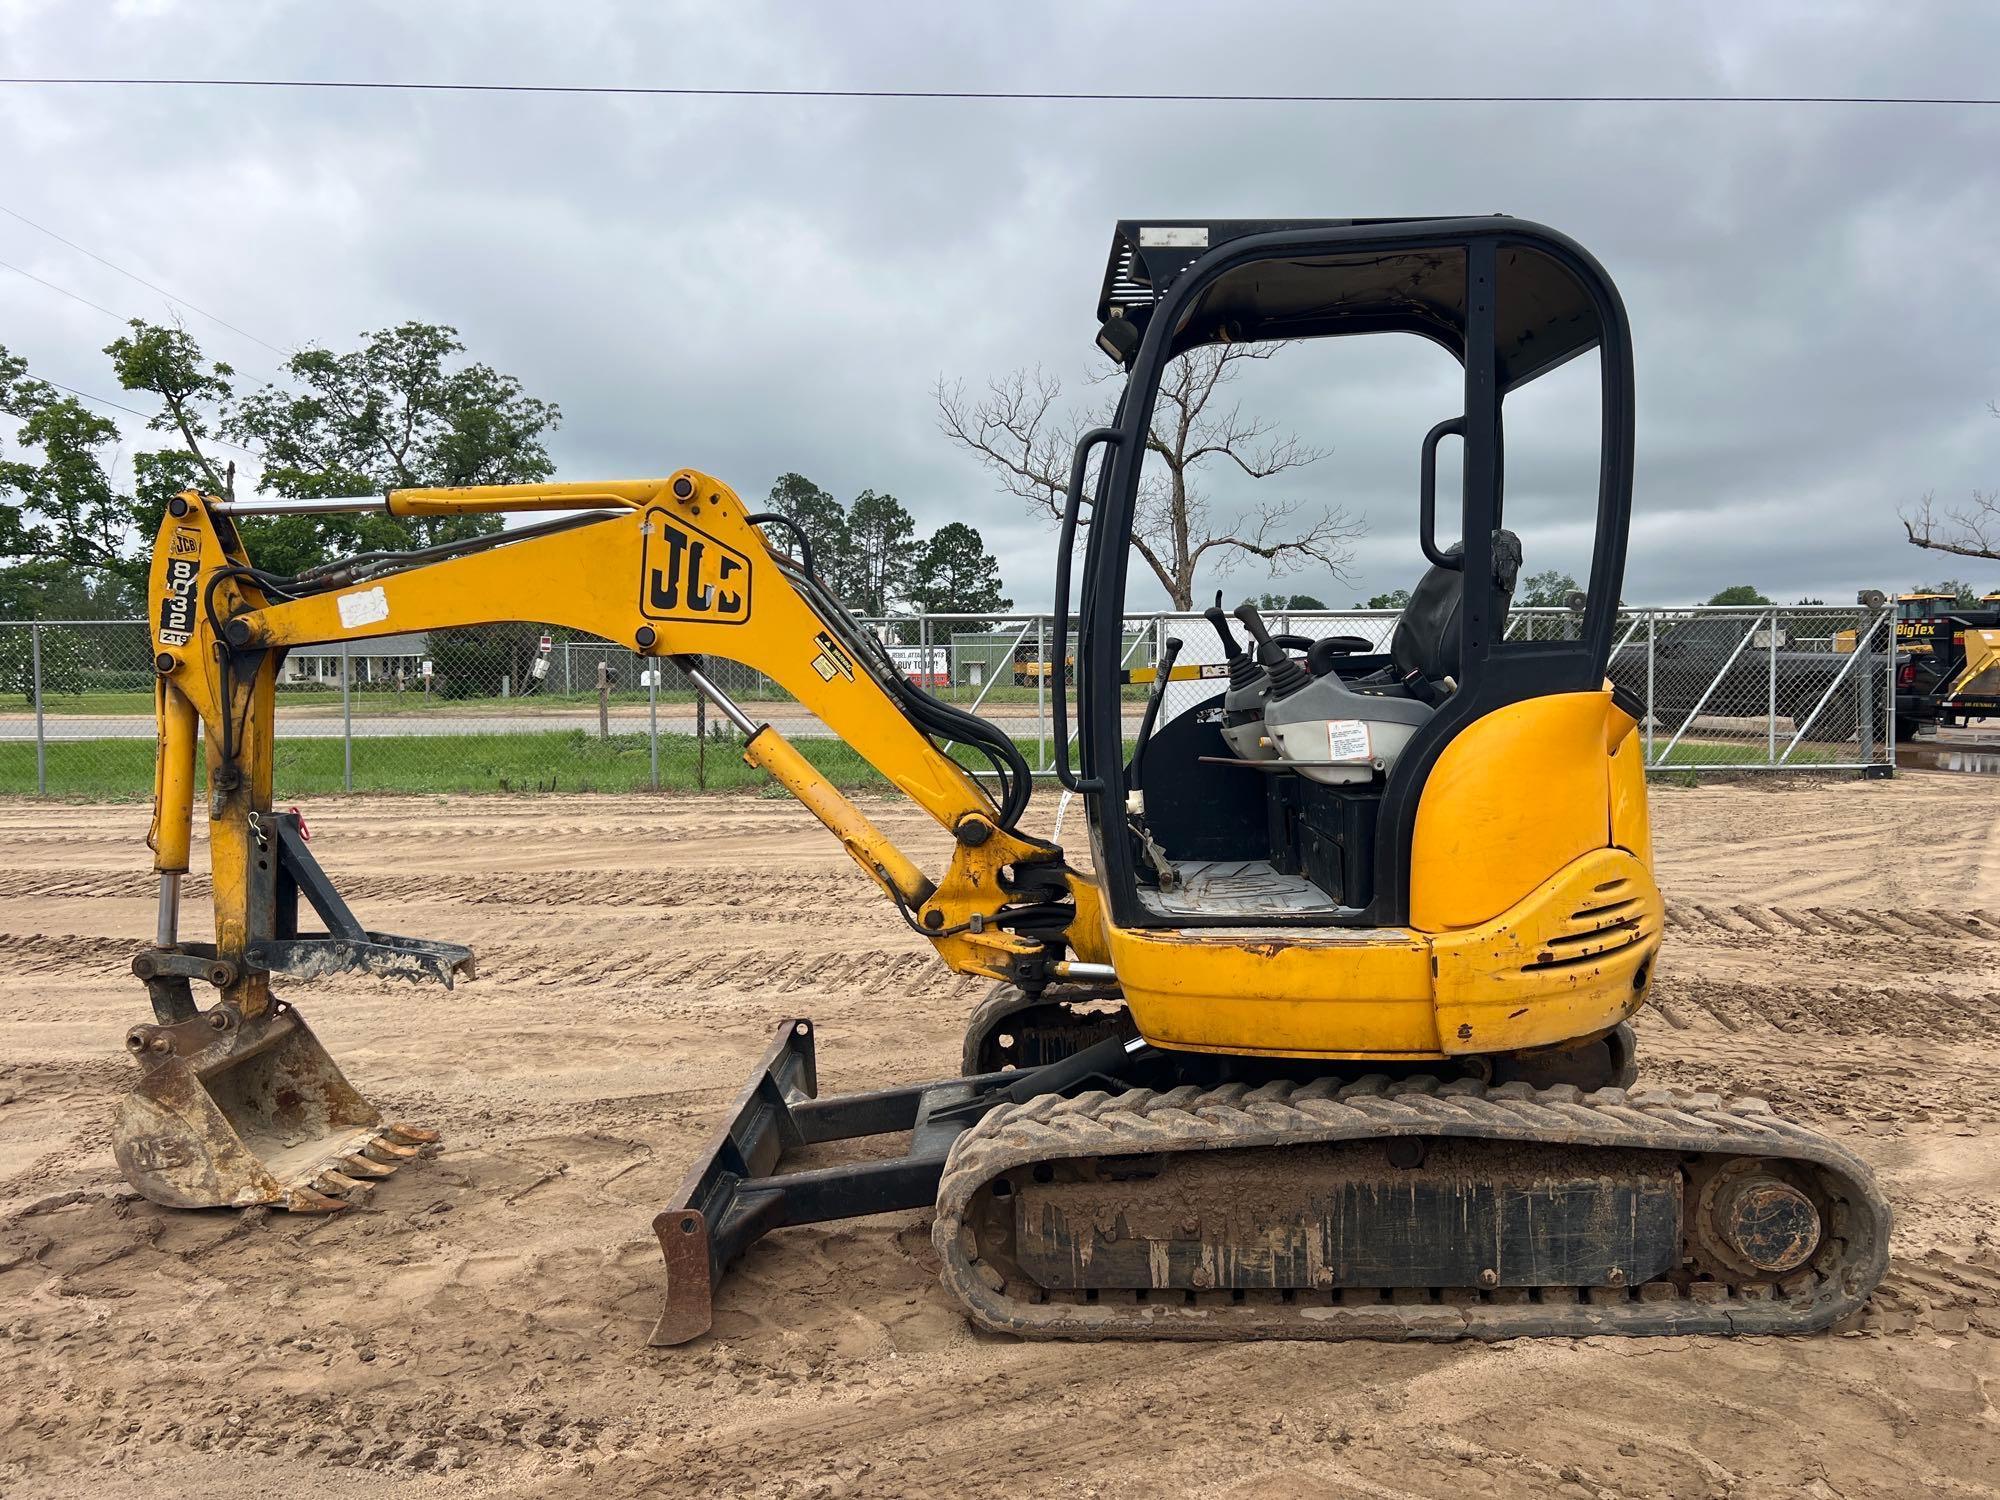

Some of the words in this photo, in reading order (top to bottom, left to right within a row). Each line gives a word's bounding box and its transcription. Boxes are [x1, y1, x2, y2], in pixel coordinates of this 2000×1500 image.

[176, 535, 196, 553] JCB
[169, 561, 191, 629] 8032
[898, 661, 911, 670] BUY
